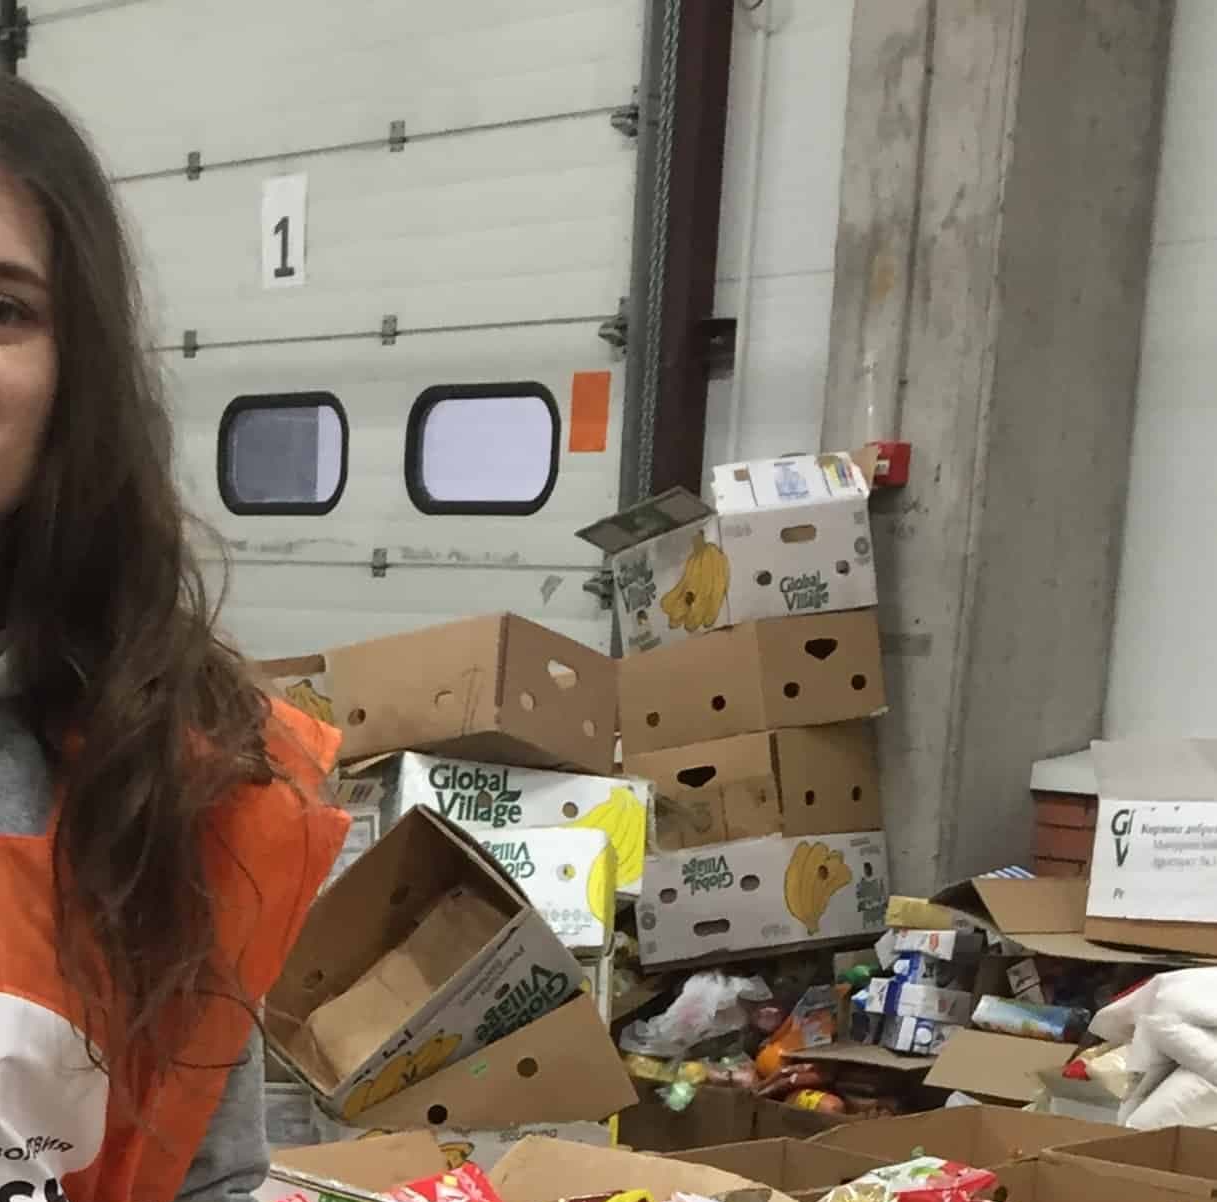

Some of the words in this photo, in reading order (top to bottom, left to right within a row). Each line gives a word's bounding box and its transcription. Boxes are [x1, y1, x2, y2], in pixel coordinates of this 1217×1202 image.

[273, 217, 295, 278] 1
[779, 570, 822, 593] Global
[784, 591, 829, 611] Village
[429, 764, 509, 792] Global
[434, 791, 522, 828] Village
[1110, 808, 1136, 836] Gl
[1115, 838, 1129, 867] V
[504, 860, 536, 879] Glo
